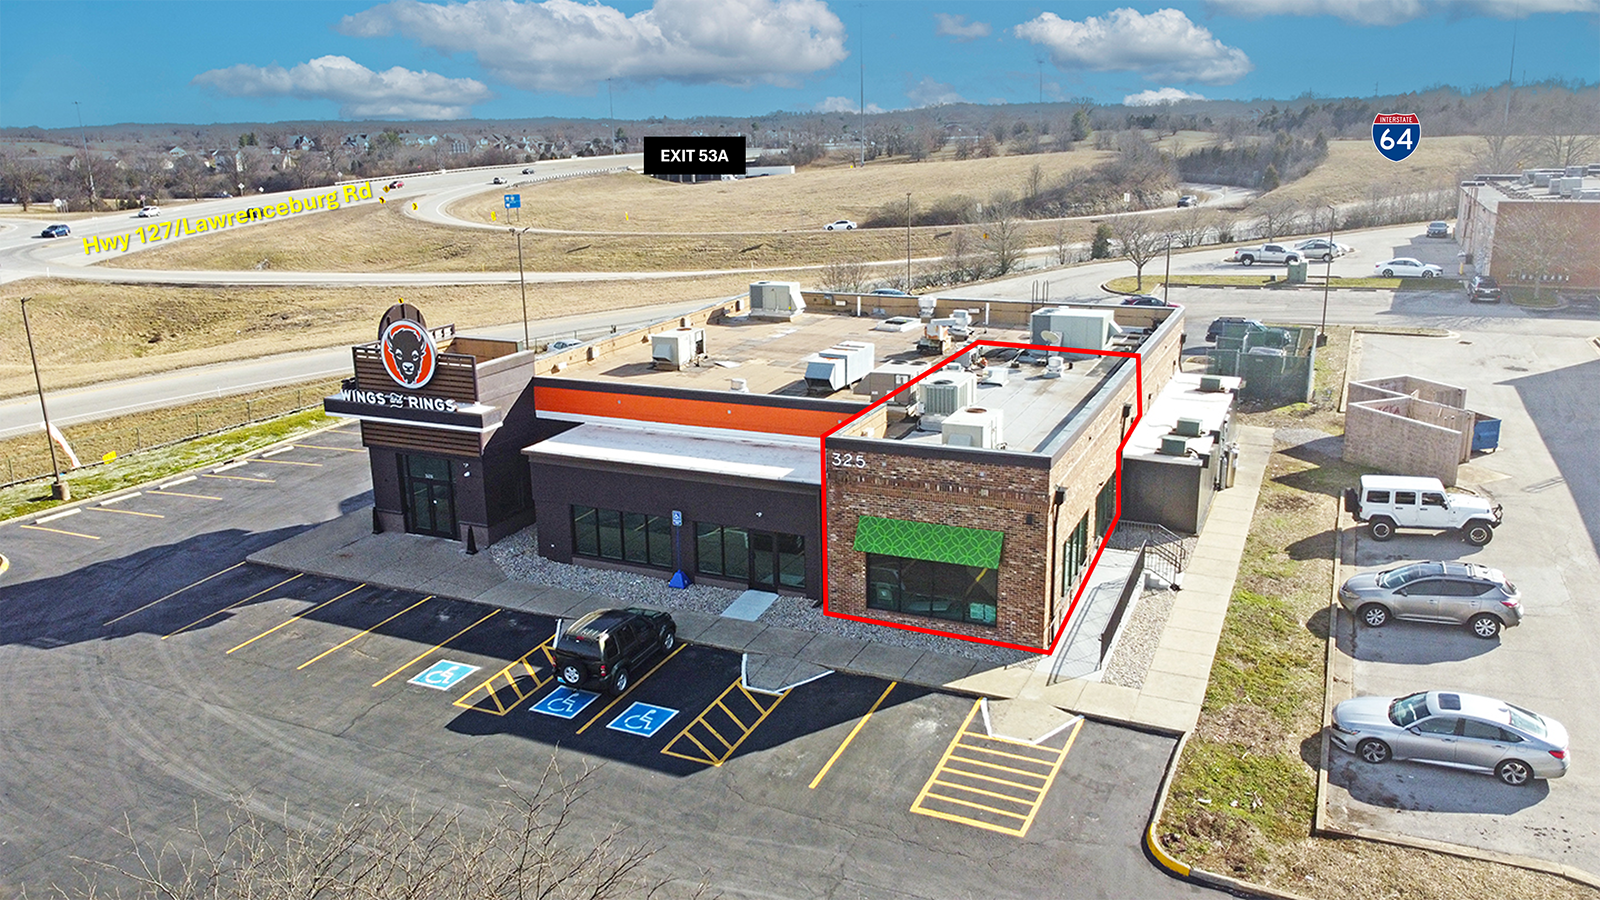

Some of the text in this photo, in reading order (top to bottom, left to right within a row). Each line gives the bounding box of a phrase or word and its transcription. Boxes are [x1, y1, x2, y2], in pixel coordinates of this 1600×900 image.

[340, 389, 386, 405] WINGS
[408, 396, 457, 412] RINGS
[832, 452, 866, 468] 325
